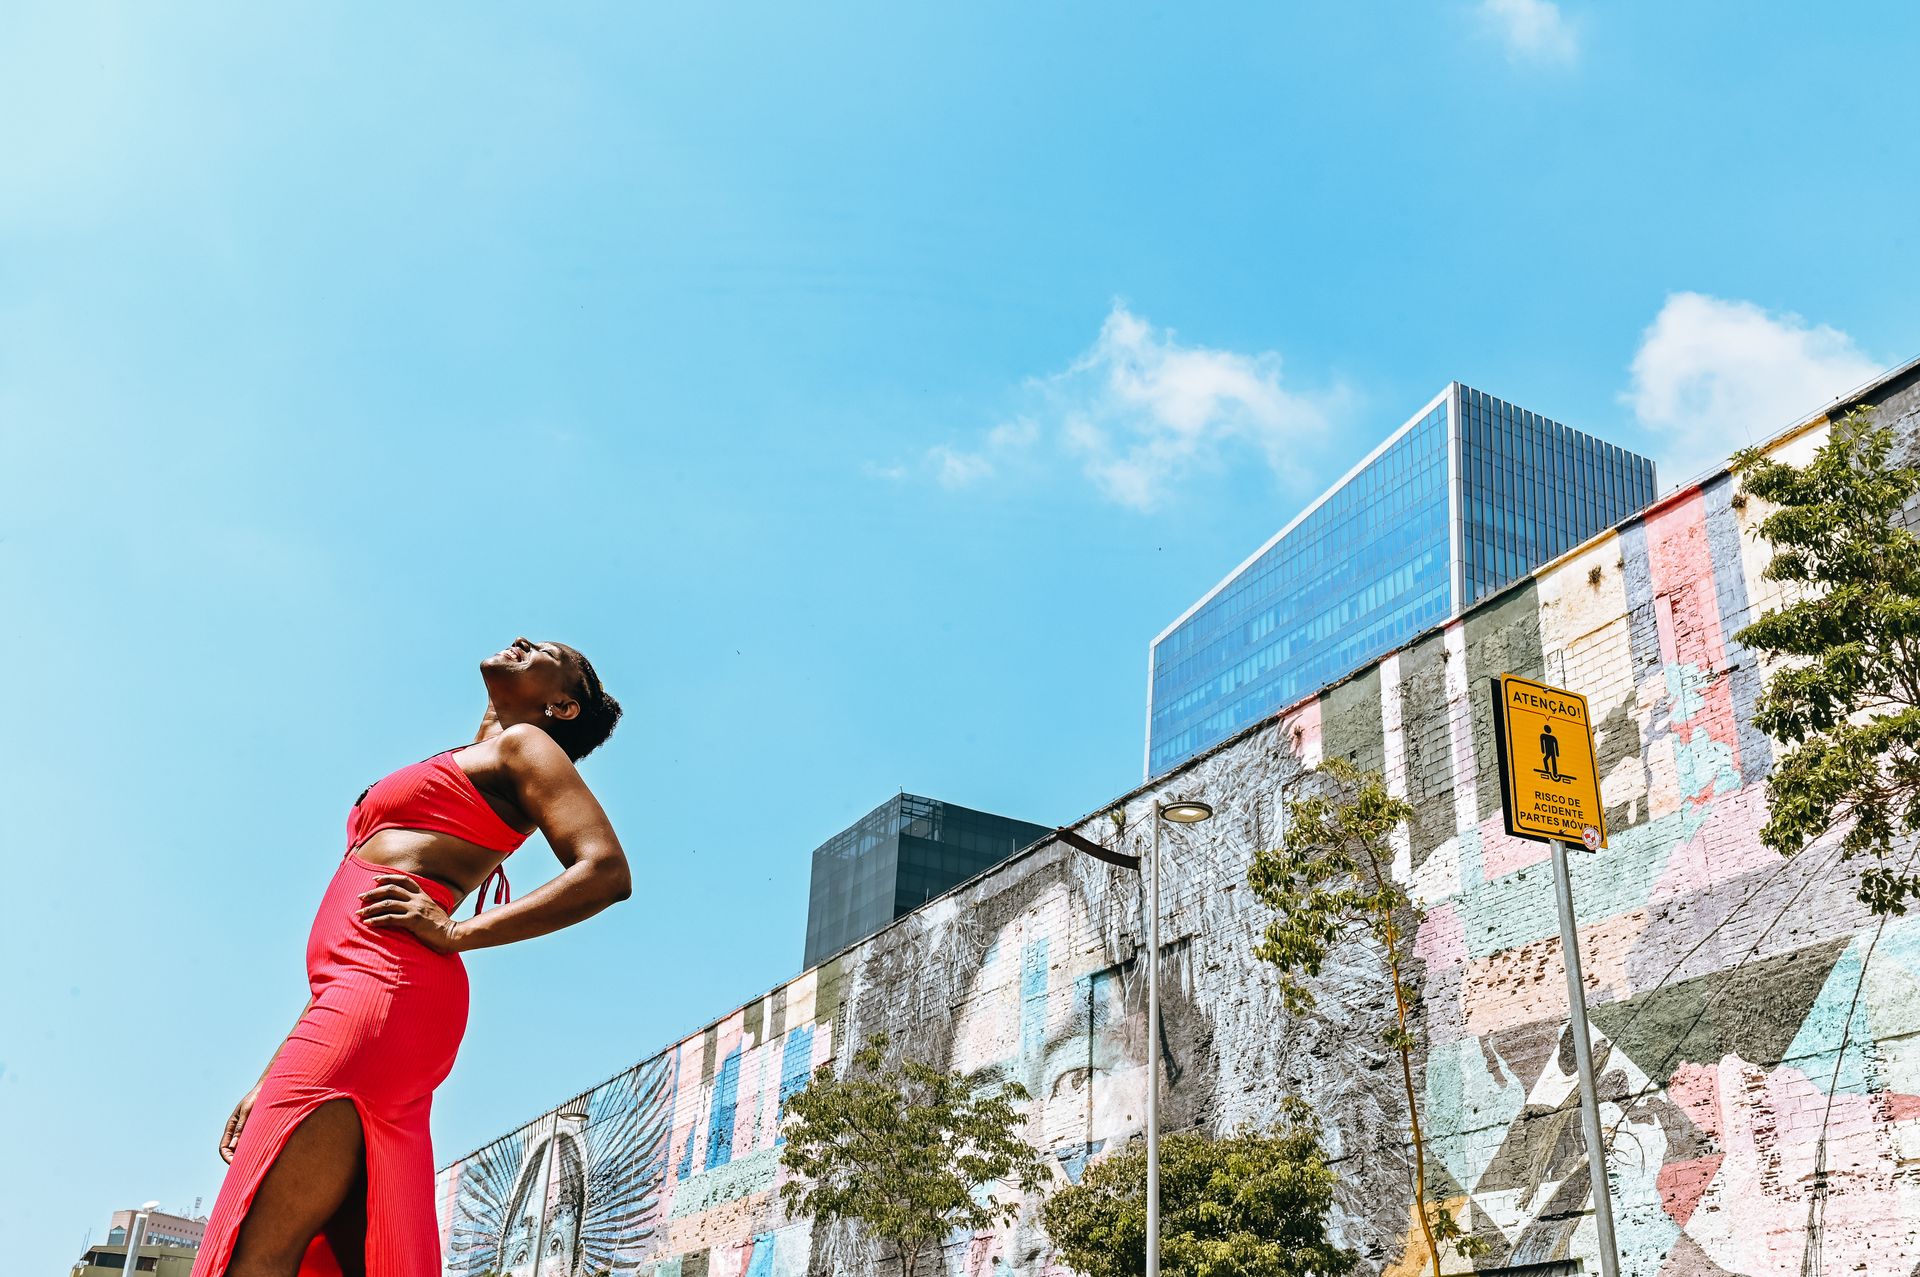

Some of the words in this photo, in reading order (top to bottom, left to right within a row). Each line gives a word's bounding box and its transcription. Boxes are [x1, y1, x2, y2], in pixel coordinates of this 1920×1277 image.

[1513, 691, 1581, 718] ATENÇÃO!
[1534, 790, 1566, 805] RISCO
[1567, 797, 1581, 808] DE
[1520, 811, 1560, 827] PARTES
[1534, 802, 1584, 820] ACIDENTE
